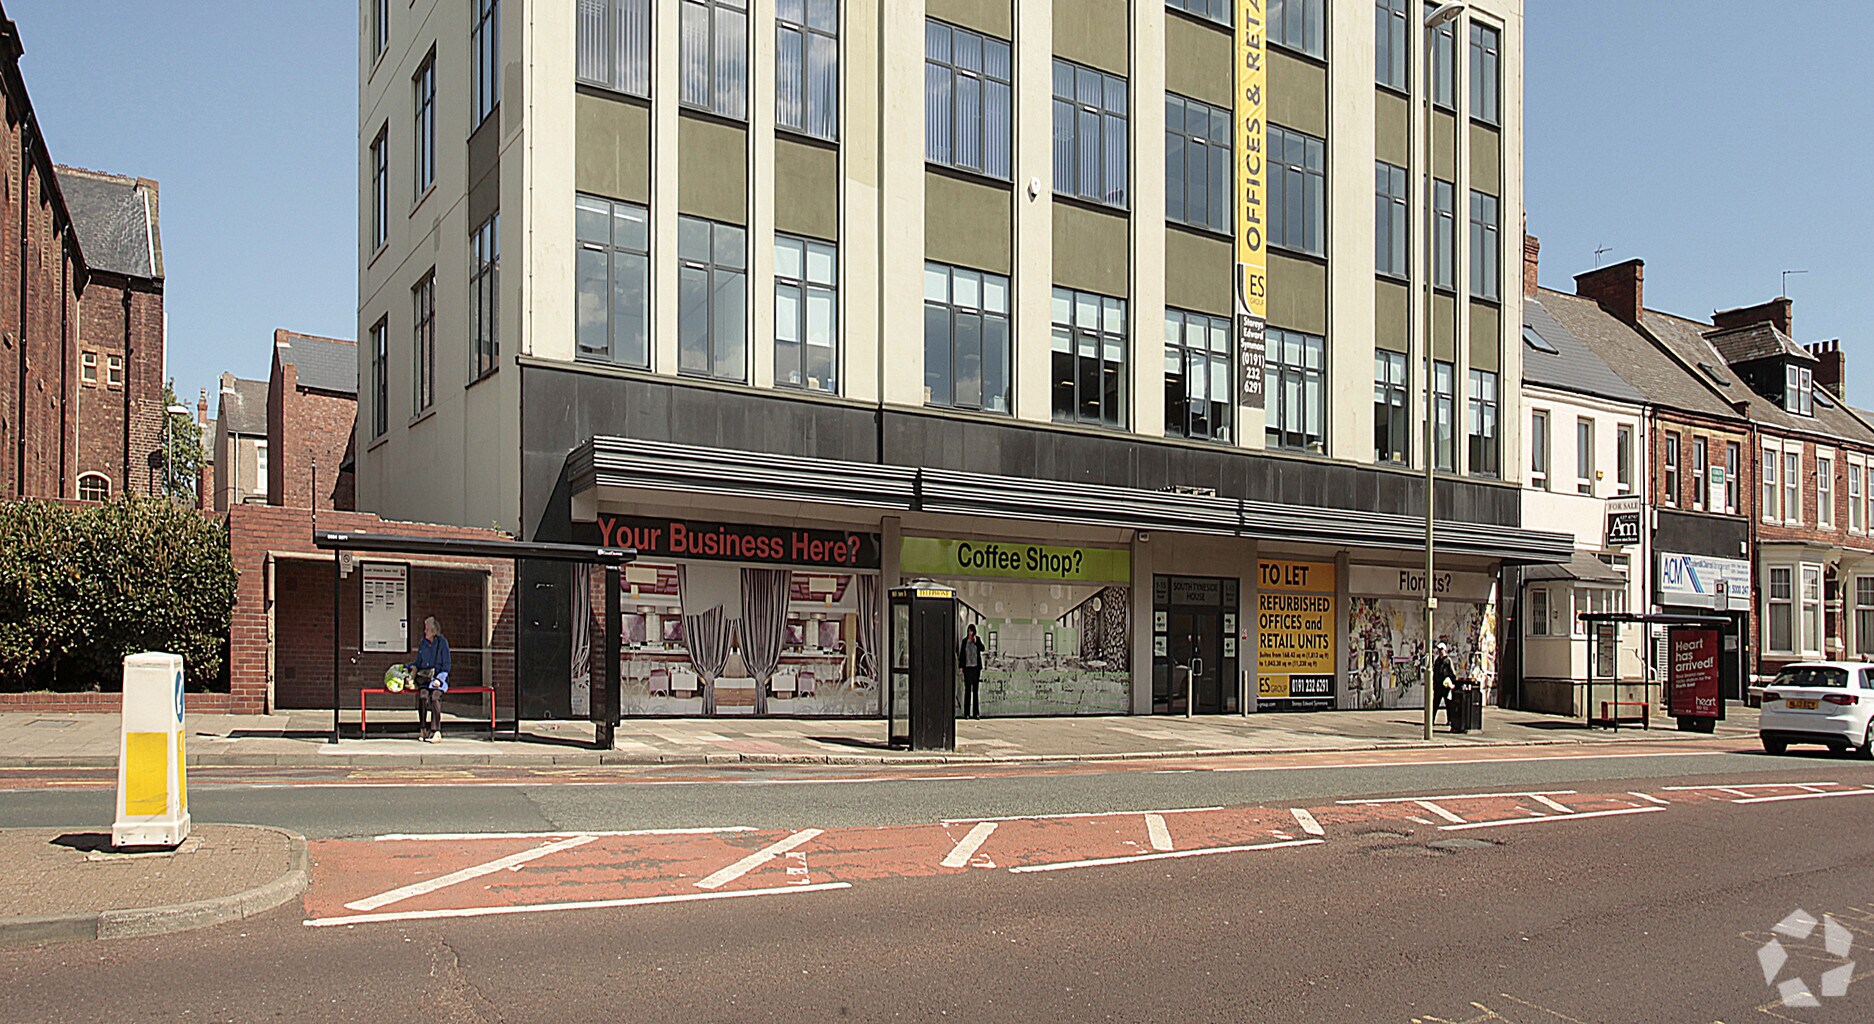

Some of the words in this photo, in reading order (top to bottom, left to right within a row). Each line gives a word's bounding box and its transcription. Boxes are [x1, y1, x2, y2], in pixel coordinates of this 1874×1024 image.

[1246, 84, 1261, 106] &
[1246, 117, 1261, 251] OFFICES
[1250, 274, 1265, 298] ES
[1243, 316, 1264, 330] Storeys
[1243, 327, 1264, 340] Edward
[1242, 352, 1265, 368] (0191)
[1246, 367, 1261, 380] 232
[1244, 381, 1262, 394] 6291
[1609, 503, 1622, 511] FOR
[1610, 517, 1638, 536] Am
[597, 517, 661, 551] Your
[669, 522, 784, 558] Business
[791, 532, 861, 563] Here?
[958, 543, 1021, 569] Coffee
[1026, 546, 1083, 577] Shop?
[1260, 564, 1280, 584] TO
[1285, 565, 1309, 585] LET
[1663, 558, 1683, 584] ACM
[1173, 582, 1193, 591] SOUTH
[1193, 583, 1217, 592] TYNESIDE
[1400, 570, 1452, 592] Florits?
[917, 590, 951, 598] TELEPHONE
[1186, 593, 1205, 601] HOUSE
[1260, 595, 1330, 612] REFURBISHED
[1260, 613, 1302, 629] OFFICES
[1305, 615, 1322, 630] and
[1260, 633, 1295, 648] RETAIL
[1298, 634, 1329, 649] UNITS
[1676, 638, 1703, 651] Heart
[1676, 652, 1693, 662] has
[1676, 657, 1714, 671] arrived!
[1260, 678, 1270, 692] ES
[1270, 685, 1287, 693] GROUP
[1292, 679, 1304, 692] 0191
[1305, 679, 1315, 692] 232
[1316, 679, 1328, 692] 6291
[1696, 696, 1716, 706] heart
